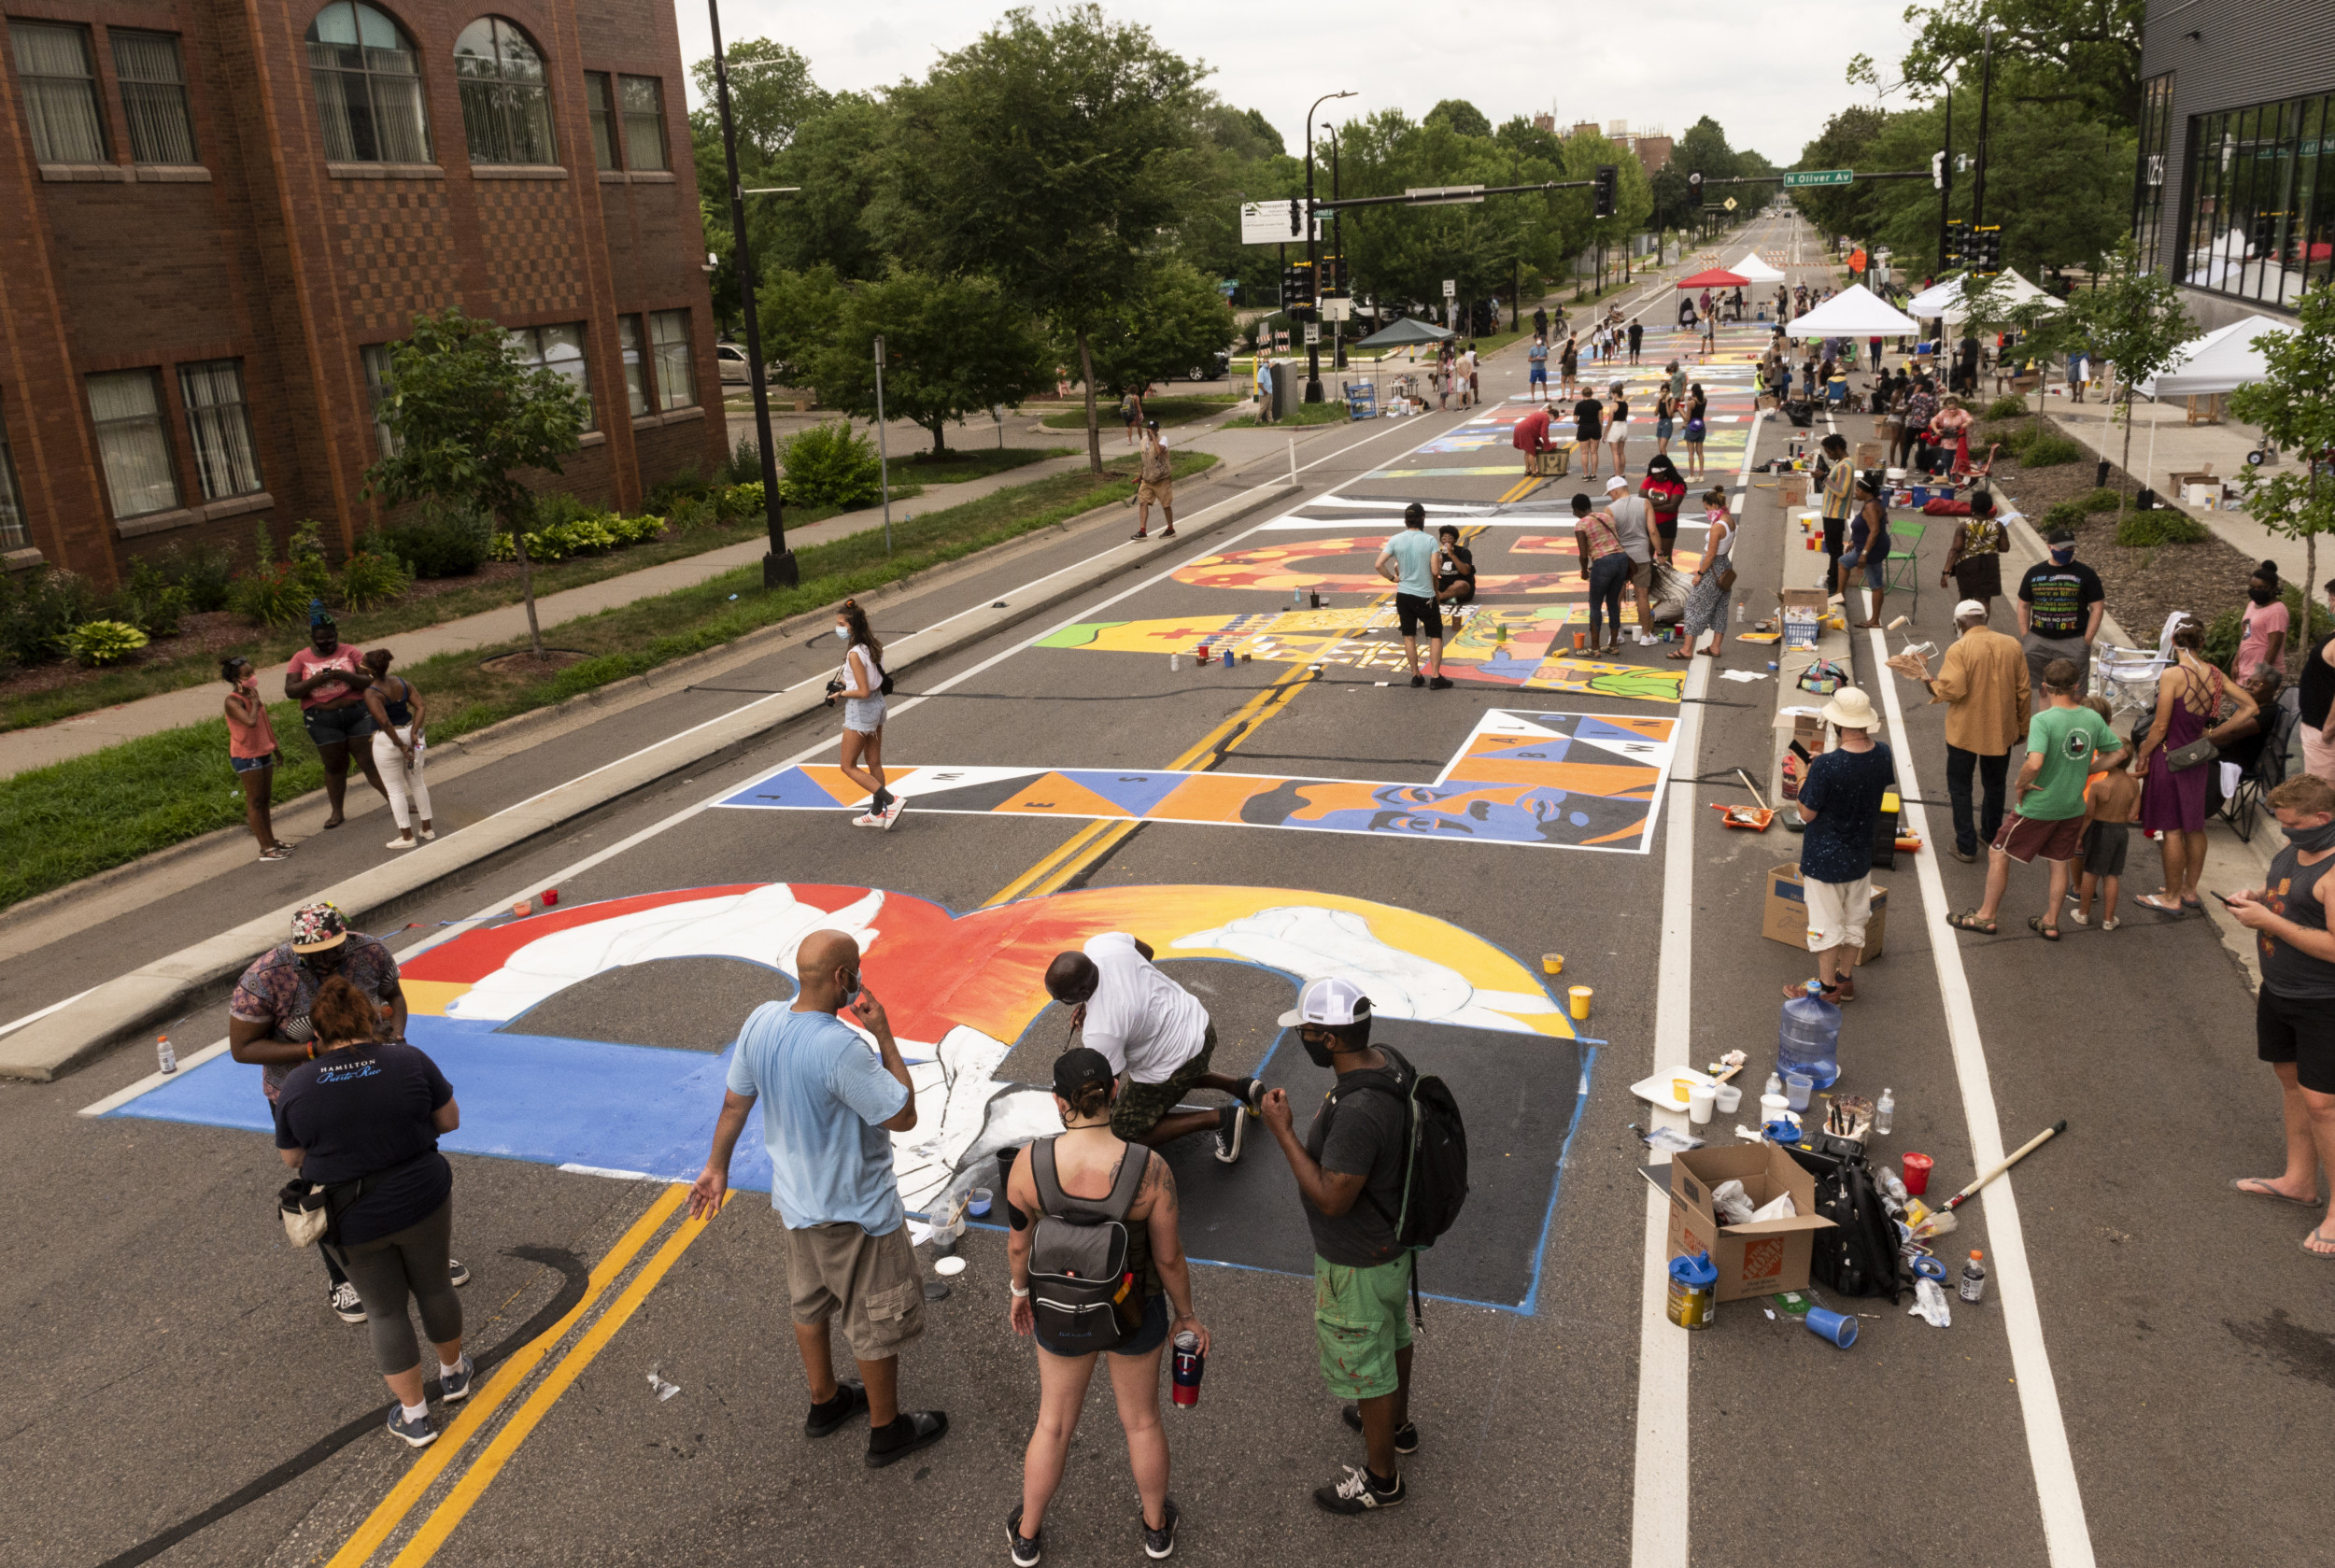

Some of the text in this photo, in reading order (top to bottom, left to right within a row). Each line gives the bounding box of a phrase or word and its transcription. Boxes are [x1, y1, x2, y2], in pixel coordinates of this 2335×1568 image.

[1787, 173, 1849, 184] N Oliver Av
[320, 1059, 375, 1072] HAMILTON
[318, 1066, 381, 1083] Puerto Rico
[1745, 1241, 1781, 1278] HOME
